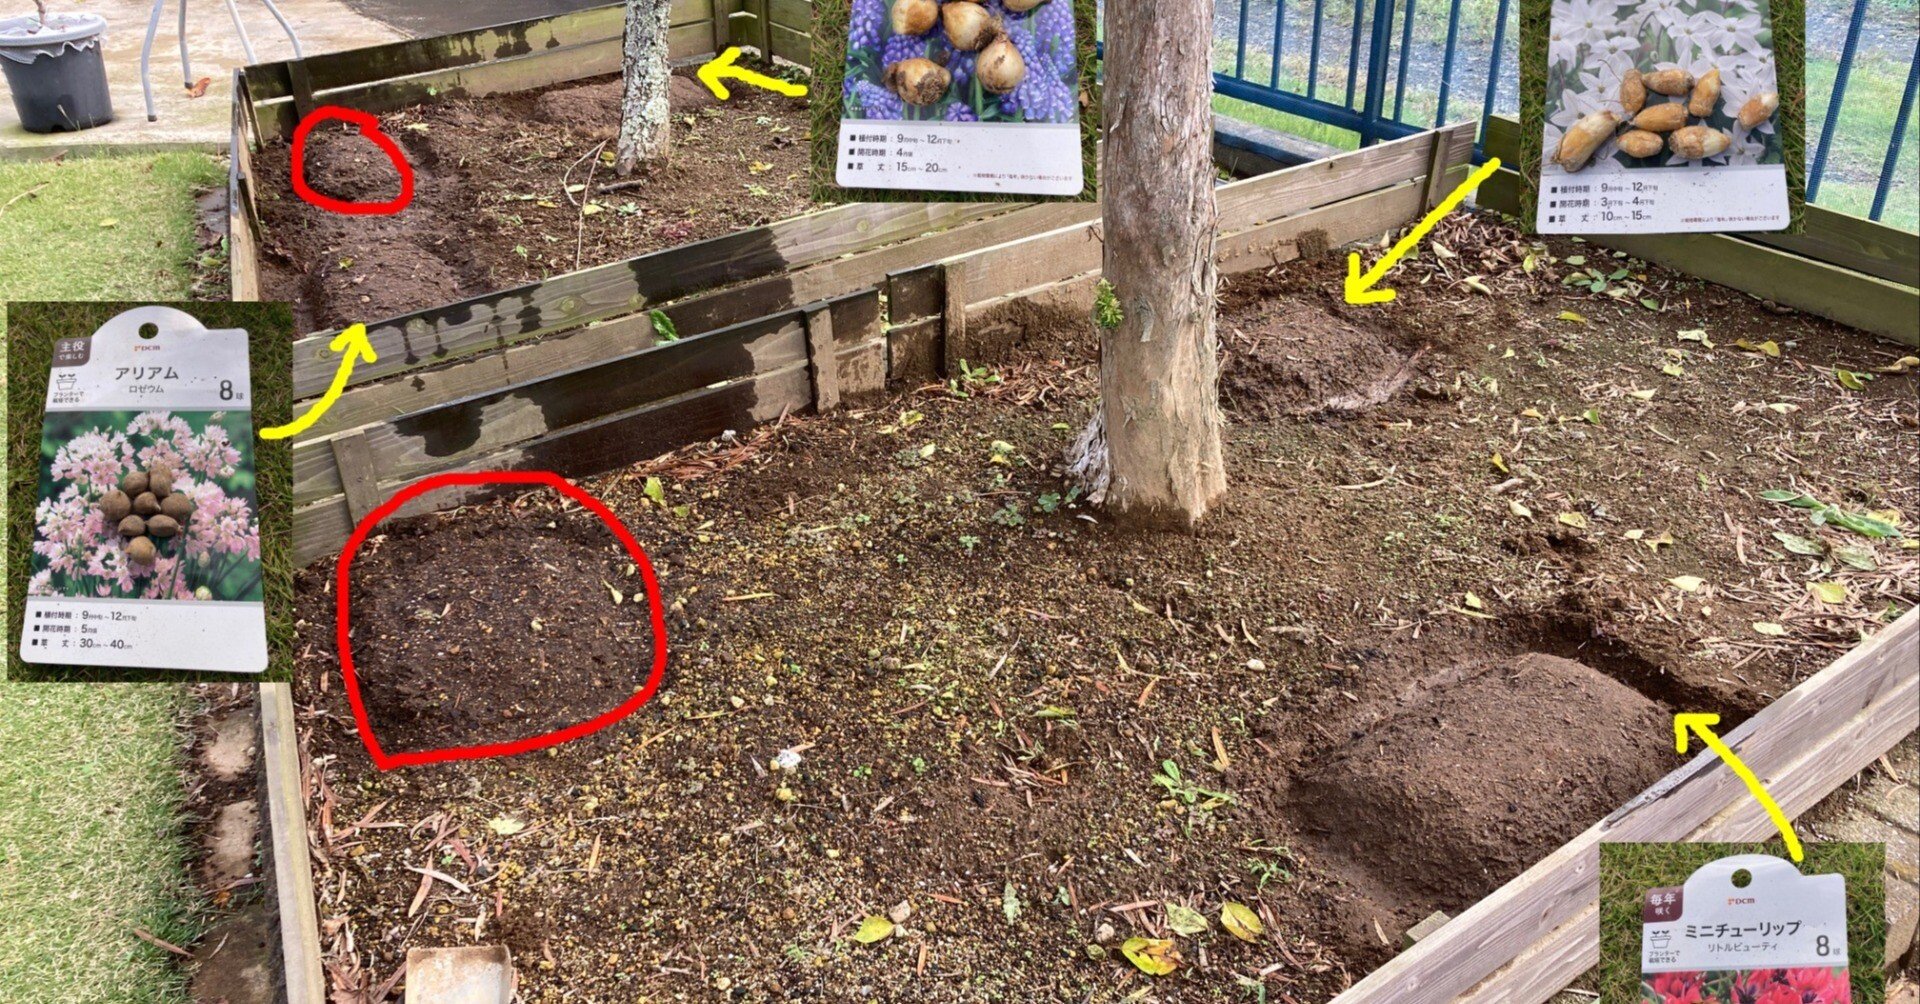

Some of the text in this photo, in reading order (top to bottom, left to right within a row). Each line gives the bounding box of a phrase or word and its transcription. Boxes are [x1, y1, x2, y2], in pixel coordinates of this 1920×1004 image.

[60, 341, 85, 353] 主役
[115, 366, 179, 380] アリアム
[129, 384, 165, 394] ロゼウム
[1650, 892, 1677, 906] 毎年
[1654, 906, 1671, 915] 咲く
[1685, 920, 1803, 939] ミニチューリップ
[1707, 941, 1779, 953] リトルビューティ
